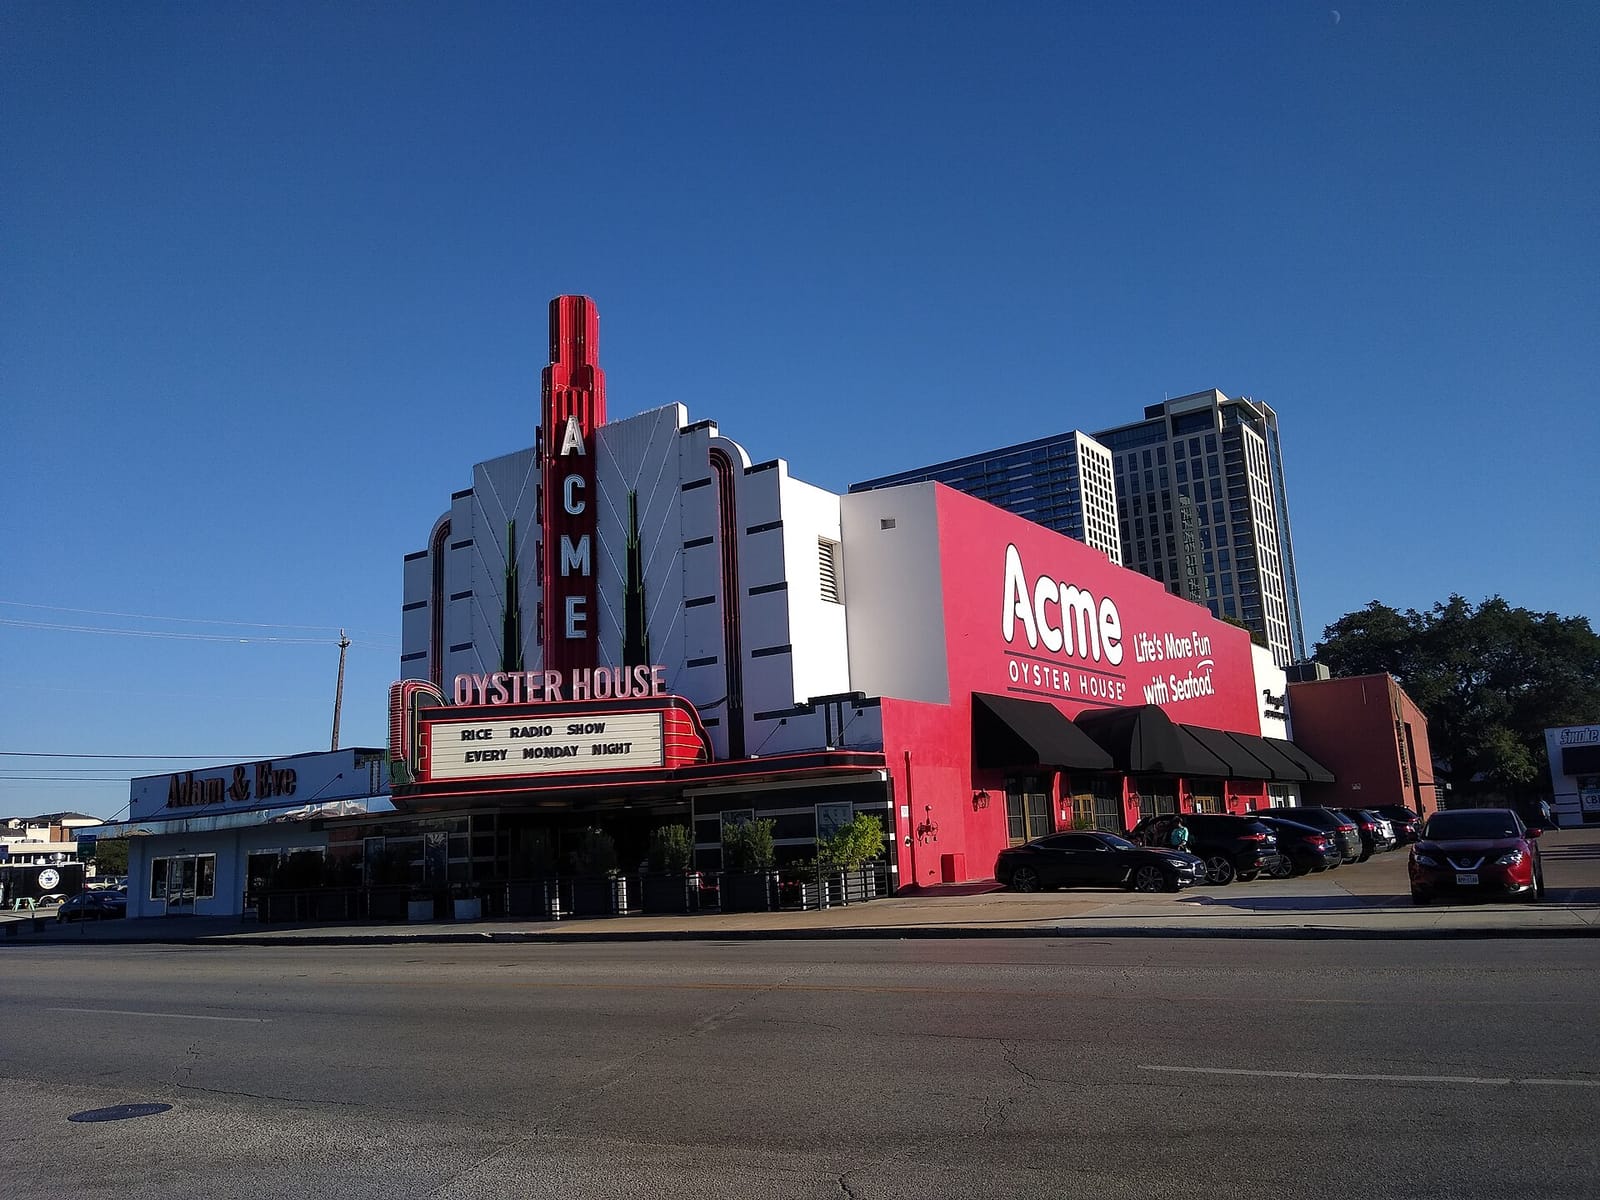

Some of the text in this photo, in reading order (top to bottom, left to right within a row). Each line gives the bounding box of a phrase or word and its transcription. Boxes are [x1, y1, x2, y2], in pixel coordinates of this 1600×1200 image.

[560, 414, 591, 639] ACME
[1002, 543, 1123, 666] Acme
[1133, 631, 1212, 663] Life's More Fun
[454, 665, 667, 705] OYSTER HOUSE
[1009, 660, 1071, 692] OYSTER
[1143, 674, 1170, 705] with
[461, 721, 606, 741] RICE RADIO SHOW
[464, 742, 632, 763] EVERY MONDAY NIGHT
[167, 761, 297, 808] Adam & Eve
[1585, 794, 1600, 805] CB
